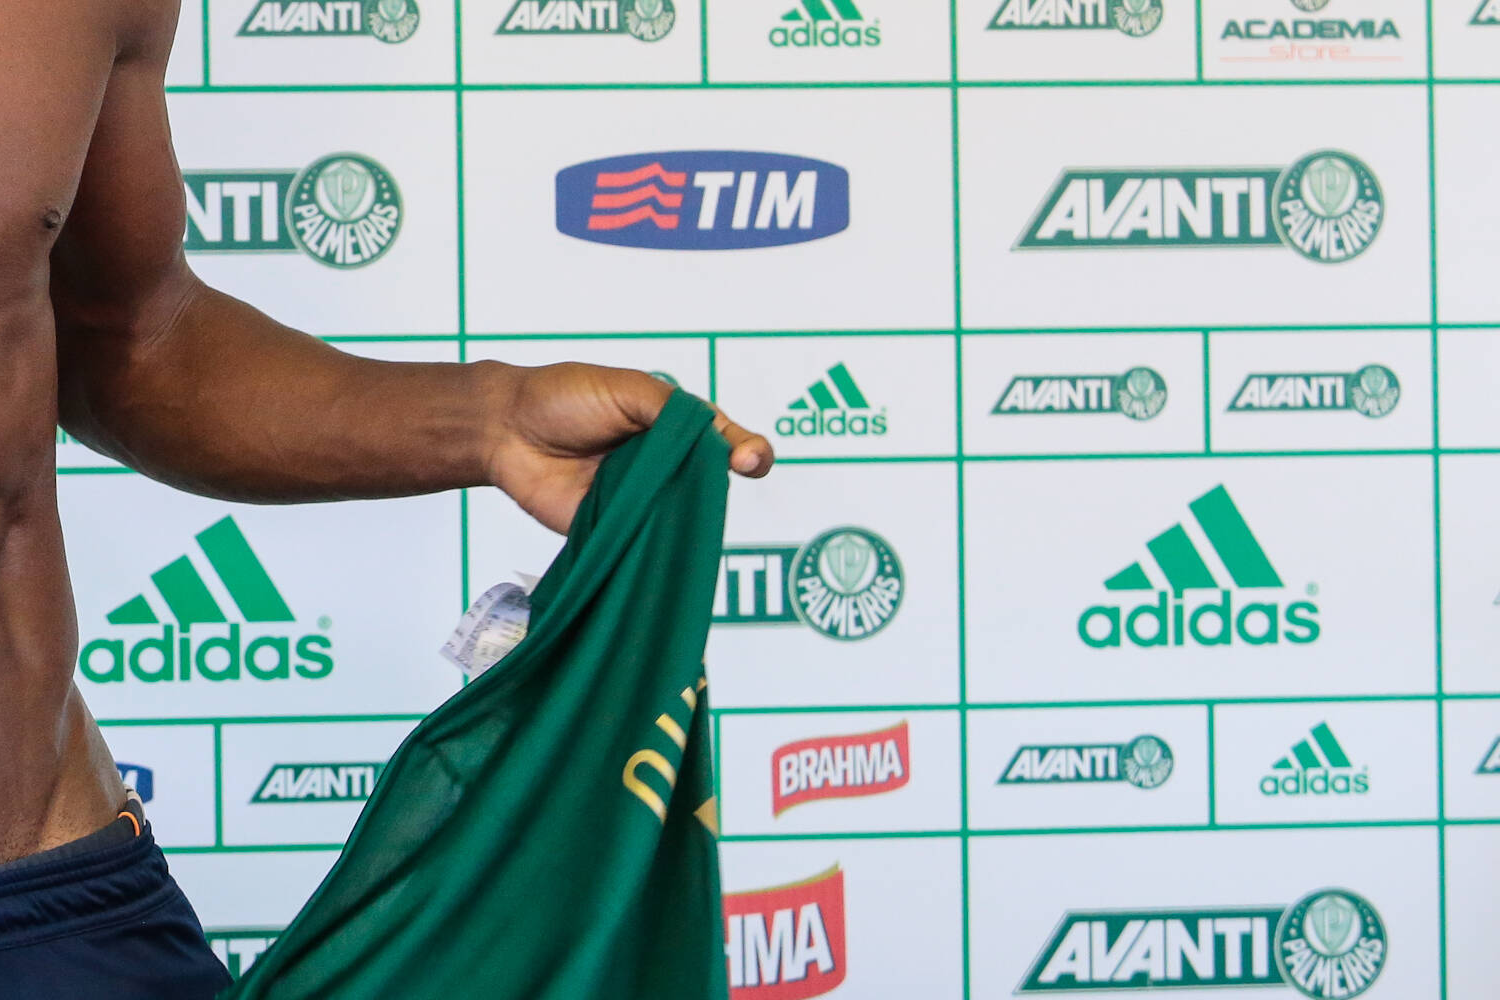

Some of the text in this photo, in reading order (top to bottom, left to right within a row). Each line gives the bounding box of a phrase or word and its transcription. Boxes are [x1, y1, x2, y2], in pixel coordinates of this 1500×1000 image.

[246, 1, 361, 32] AVANTI
[504, 0, 618, 30] AVANTI
[769, 18, 881, 48] adidas
[1220, 19, 1400, 40] ACADEMIA
[694, 171, 817, 230] TIM
[1036, 178, 1266, 239] AVANTI
[1280, 197, 1380, 258] PALMEIRAS
[295, 203, 399, 263] PALMEIRAS
[1000, 379, 1110, 411] AVANTI
[1236, 377, 1344, 408] AVANTI
[775, 406, 887, 437] adidas
[797, 574, 900, 637] PALMEIRAS
[1078, 592, 1320, 648] adidas
[80, 624, 333, 683] adidas
[780, 740, 902, 796] BRAHMA
[1005, 747, 1116, 779] AVANTI
[1261, 767, 1369, 796] adidas
[1038, 918, 1269, 982] AVANTI
[1283, 937, 1383, 998] PALMEIRAS
